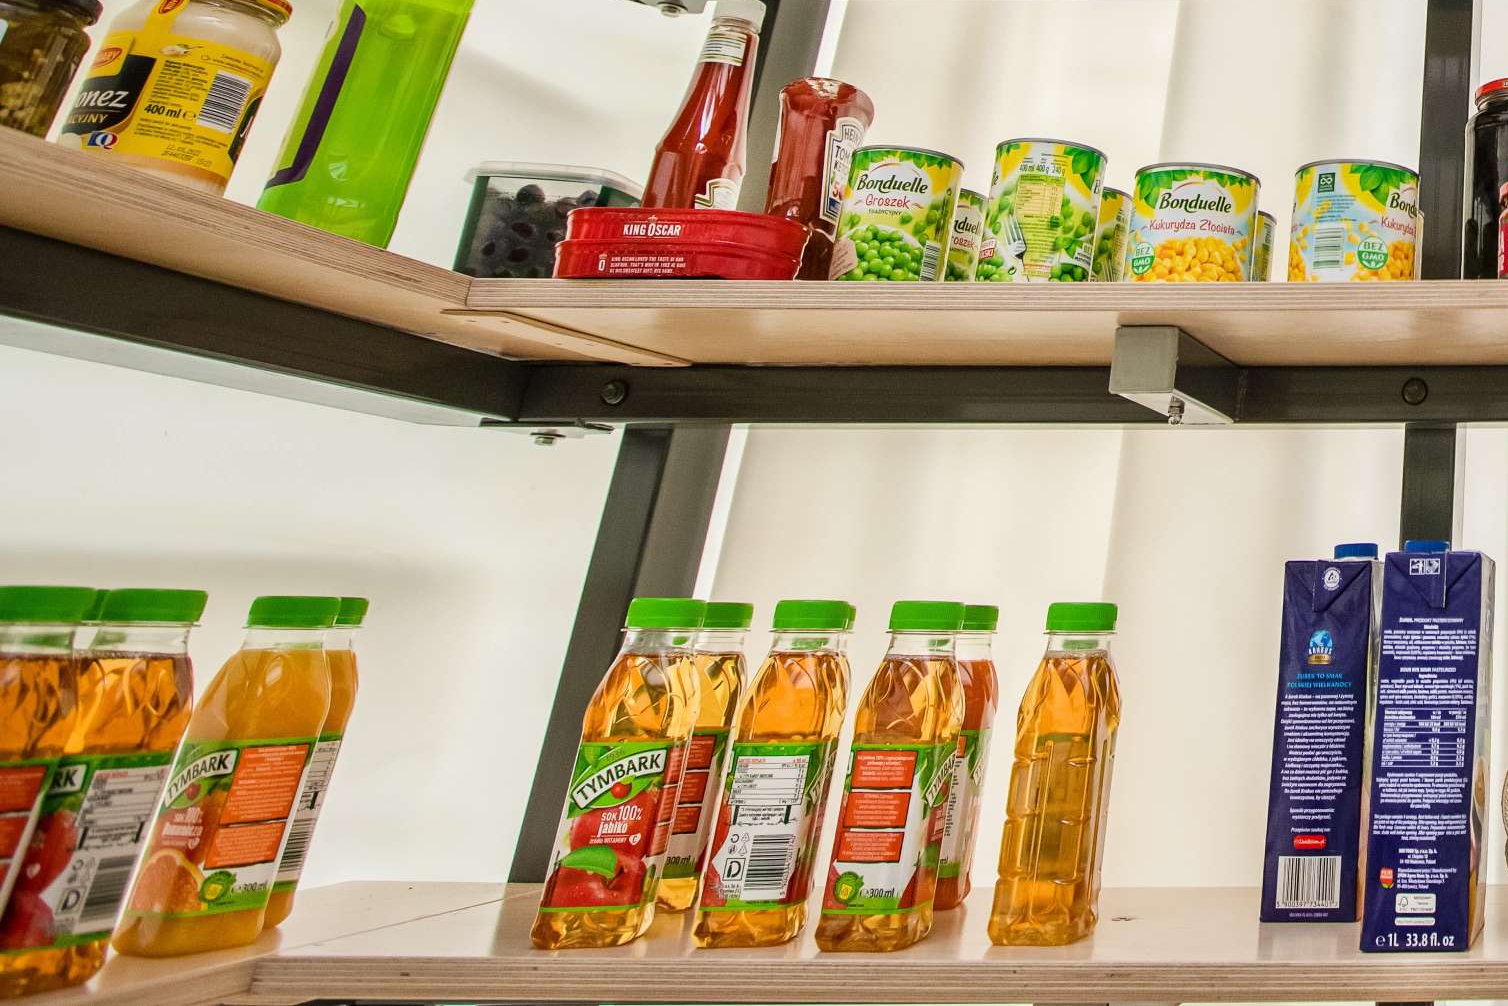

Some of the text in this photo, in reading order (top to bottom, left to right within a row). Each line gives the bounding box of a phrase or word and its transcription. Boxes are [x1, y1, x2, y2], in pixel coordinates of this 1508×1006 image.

[144, 104, 181, 118] 400 ml
[857, 173, 929, 194] Bonduelle
[865, 193, 911, 209] Groszek
[1159, 192, 1232, 213] Bonduelle
[623, 223, 681, 237] KING OSCAR
[1149, 219, 1235, 235] Kukurydza Złocista
[1136, 246, 1150, 256] BEZ
[1363, 241, 1384, 251] BEZ
[1133, 257, 1151, 266] GMO
[1362, 252, 1385, 261] GMO
[167, 753, 231, 798] TYMBARK
[576, 752, 662, 801] TYMBARK
[618, 805, 643, 821] 100%
[869, 887, 895, 899] 300 ml
[1387, 933, 1400, 947] 1L
[1405, 933, 1428, 947] 33.8
[1430, 931, 1441, 947] fl.
[1442, 935, 1456, 947] oz
